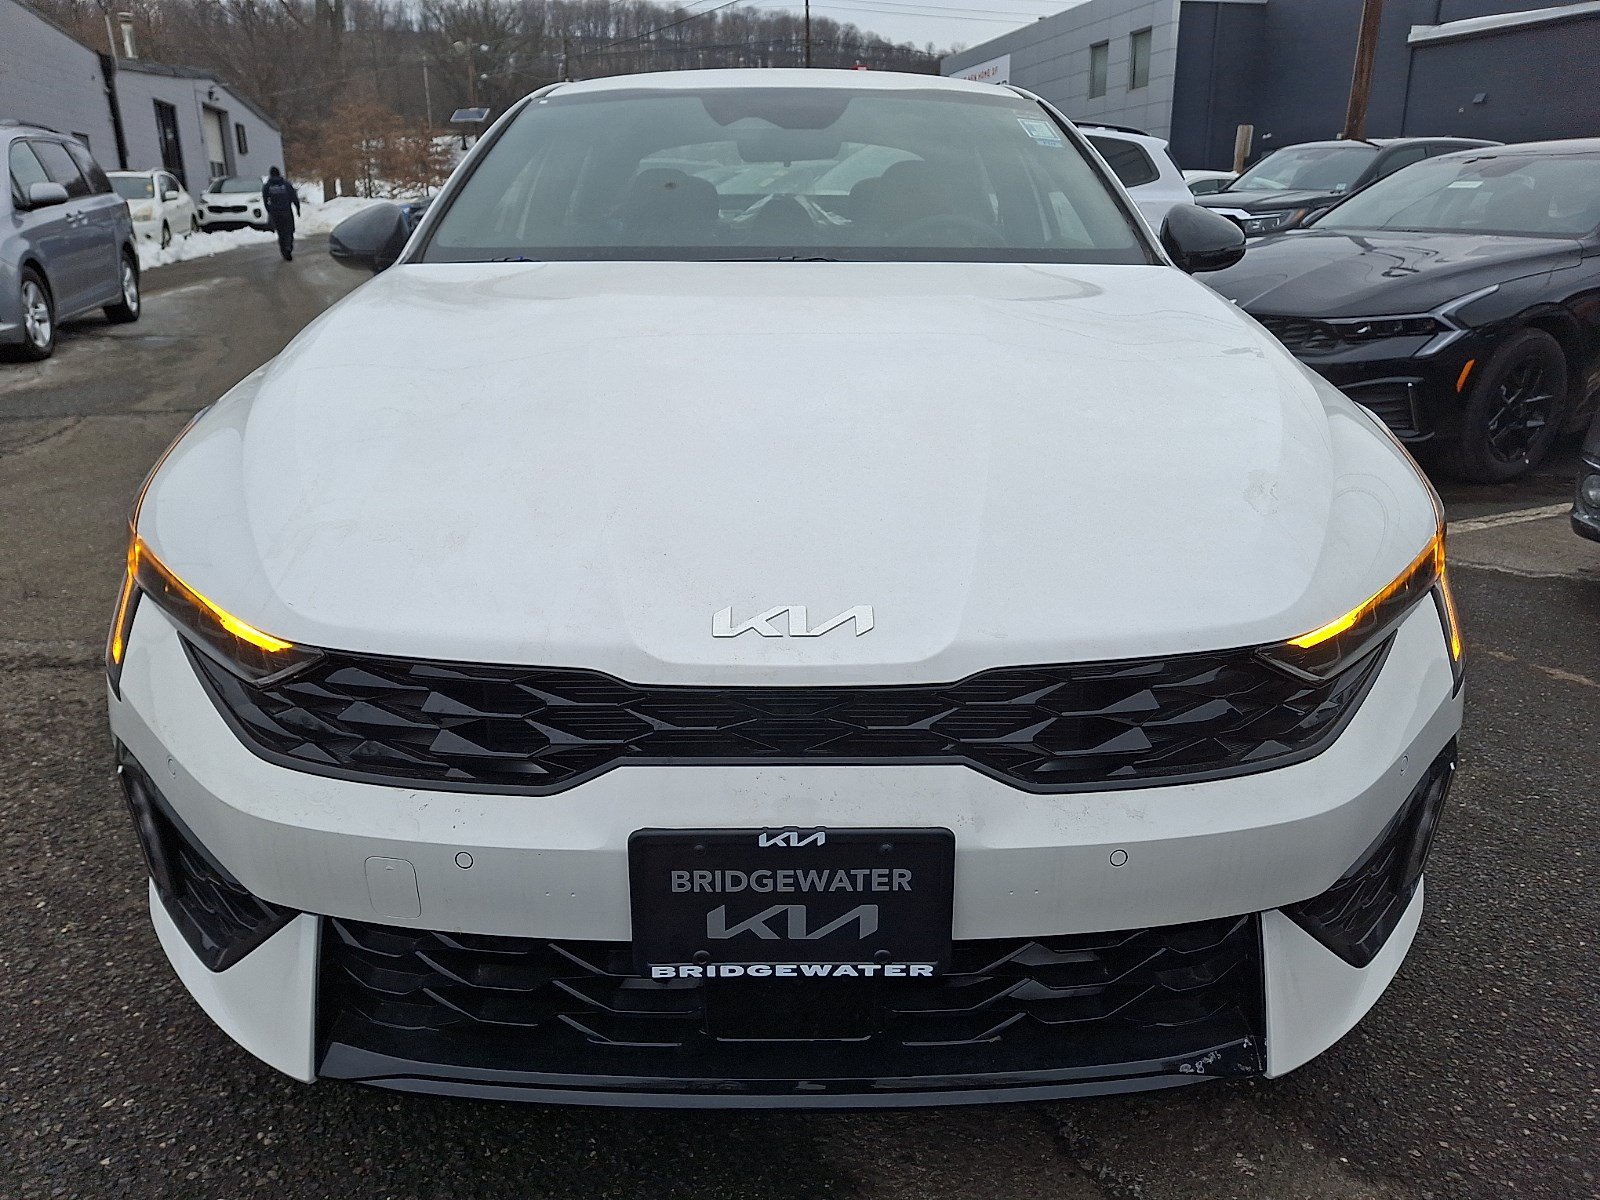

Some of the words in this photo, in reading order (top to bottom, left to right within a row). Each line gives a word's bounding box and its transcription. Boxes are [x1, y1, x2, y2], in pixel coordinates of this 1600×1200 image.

[712, 605, 875, 638] KIA
[758, 831, 826, 847] KIA
[670, 868, 913, 893] BRIDGEWATER
[706, 904, 879, 940] KIA
[651, 964, 934, 978] BRIDGEWATER
